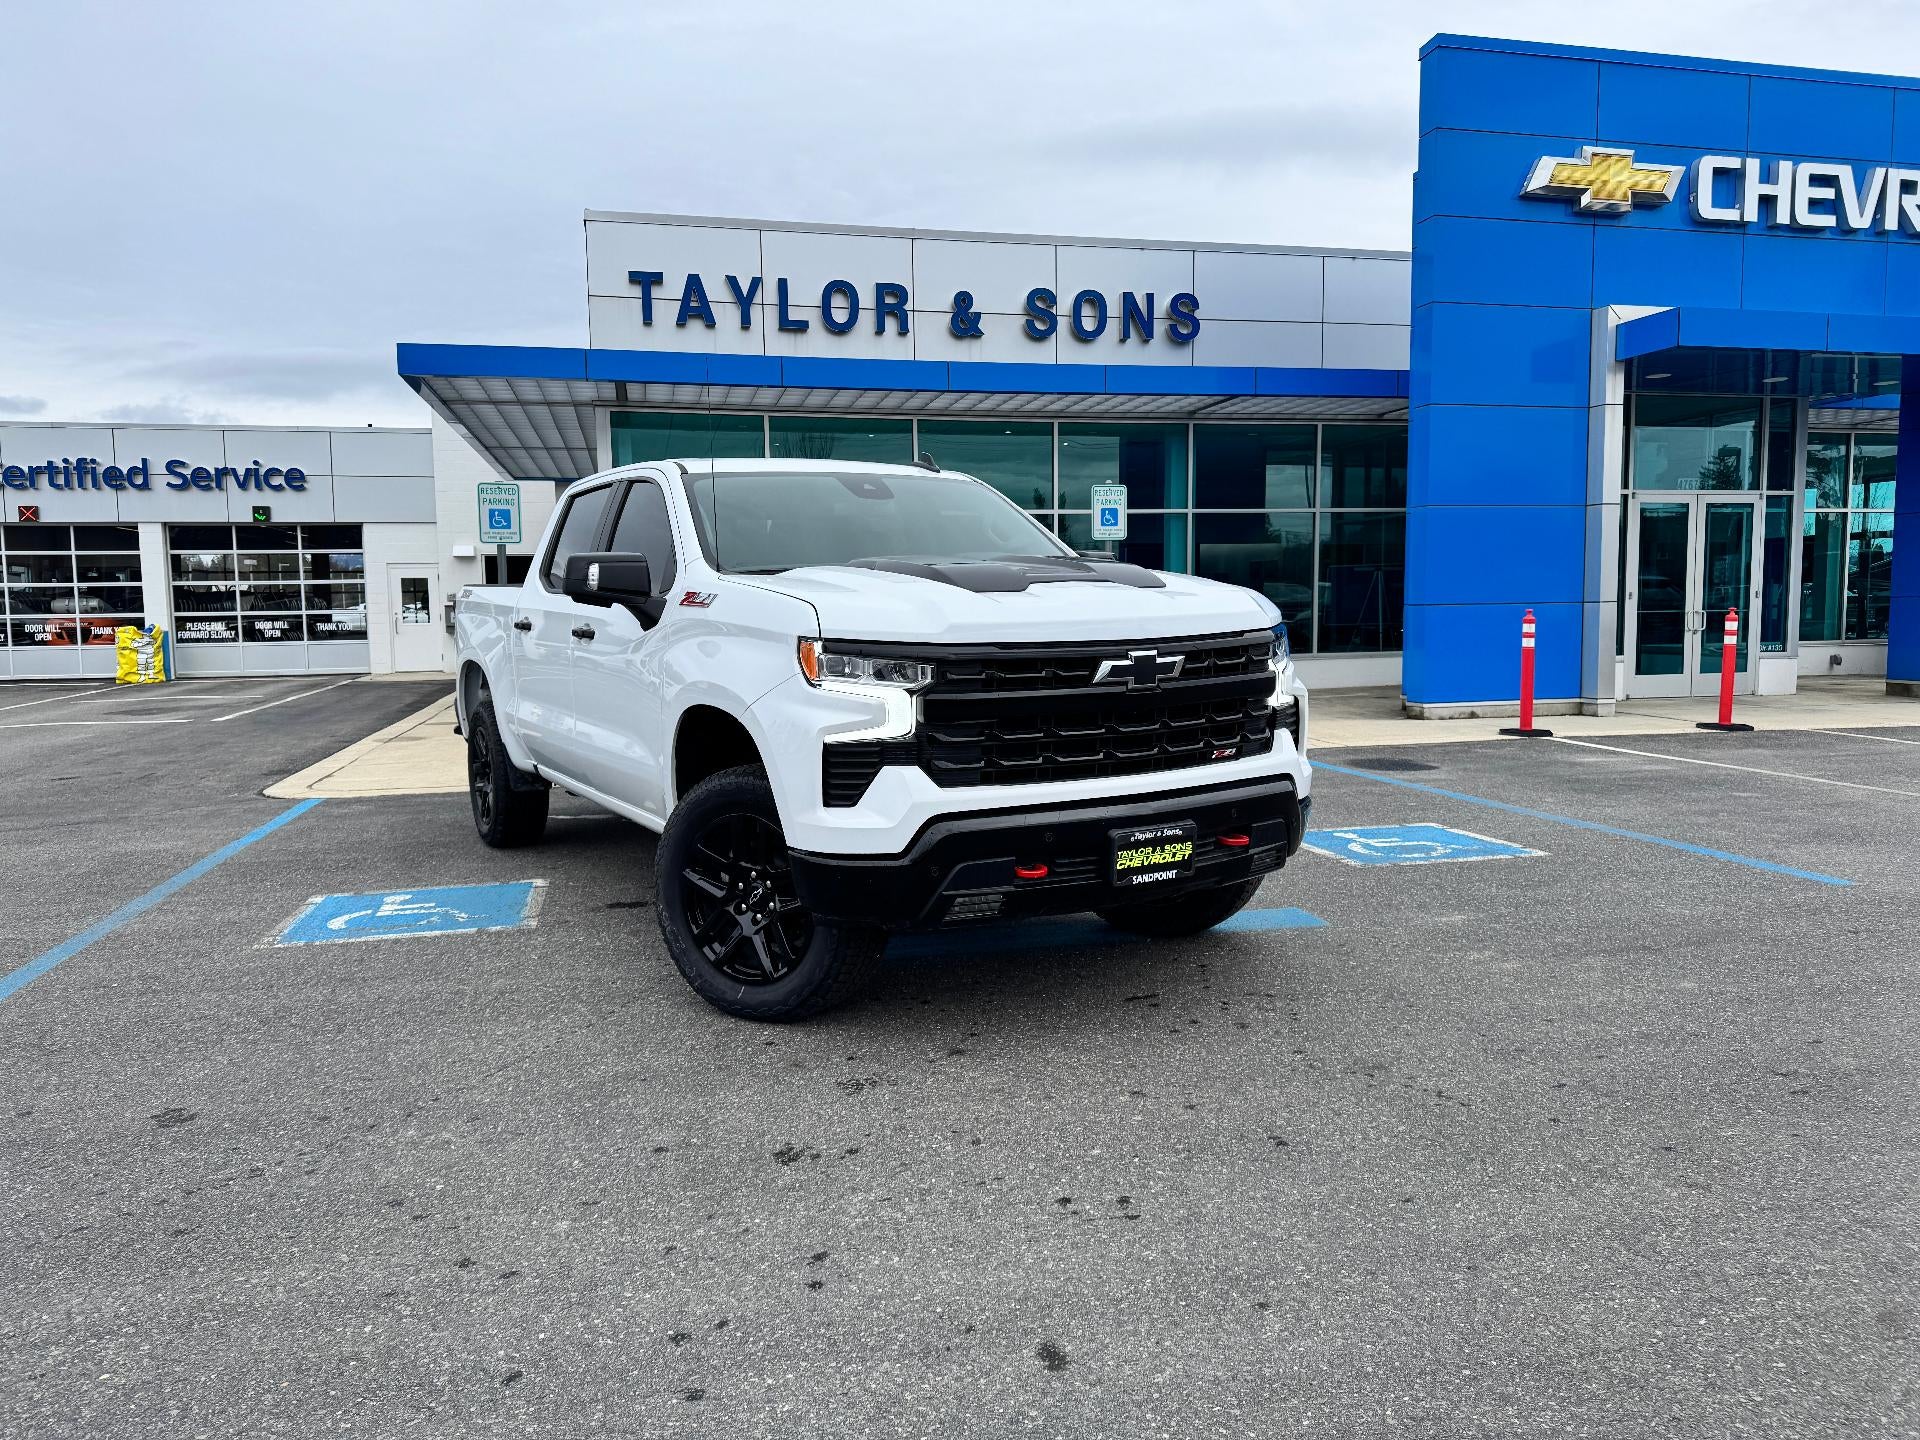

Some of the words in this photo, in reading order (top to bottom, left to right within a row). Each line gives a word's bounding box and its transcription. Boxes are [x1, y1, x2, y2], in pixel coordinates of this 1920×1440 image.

[628, 270, 910, 336] TAYLOR
[950, 289, 985, 338] &
[1023, 287, 1201, 344] SONS
[0, 457, 151, 491] ertified
[165, 459, 306, 491] Service
[480, 487, 517, 496] RESERVED
[1094, 489, 1124, 497] RESERVED
[482, 497, 515, 507] PARKING
[1096, 498, 1122, 506] PARKING
[24, 624, 43, 633] DOOR
[45, 624, 61, 632] WILL
[186, 622, 210, 631] PLEASE
[211, 622, 227, 630] PULL
[255, 621, 272, 630] DOOR
[273, 621, 289, 629] WILL
[316, 623, 337, 631] THANK
[90, 626, 113, 635] THANK
[177, 631, 209, 639] FORWARD
[210, 630, 235, 639] SLOWLY
[264, 630, 281, 638] OPEN
[34, 633, 52, 641] OPEN
[1135, 830, 1156, 841] Taylor
[1163, 828, 1179, 837] Sons
[1117, 846, 1152, 859] TAYLOR
[1155, 846, 1162, 854] &
[1164, 842, 1193, 853] SONS
[1116, 850, 1193, 870] CHEVROLET
[1132, 869, 1178, 885] SANDPOINT
